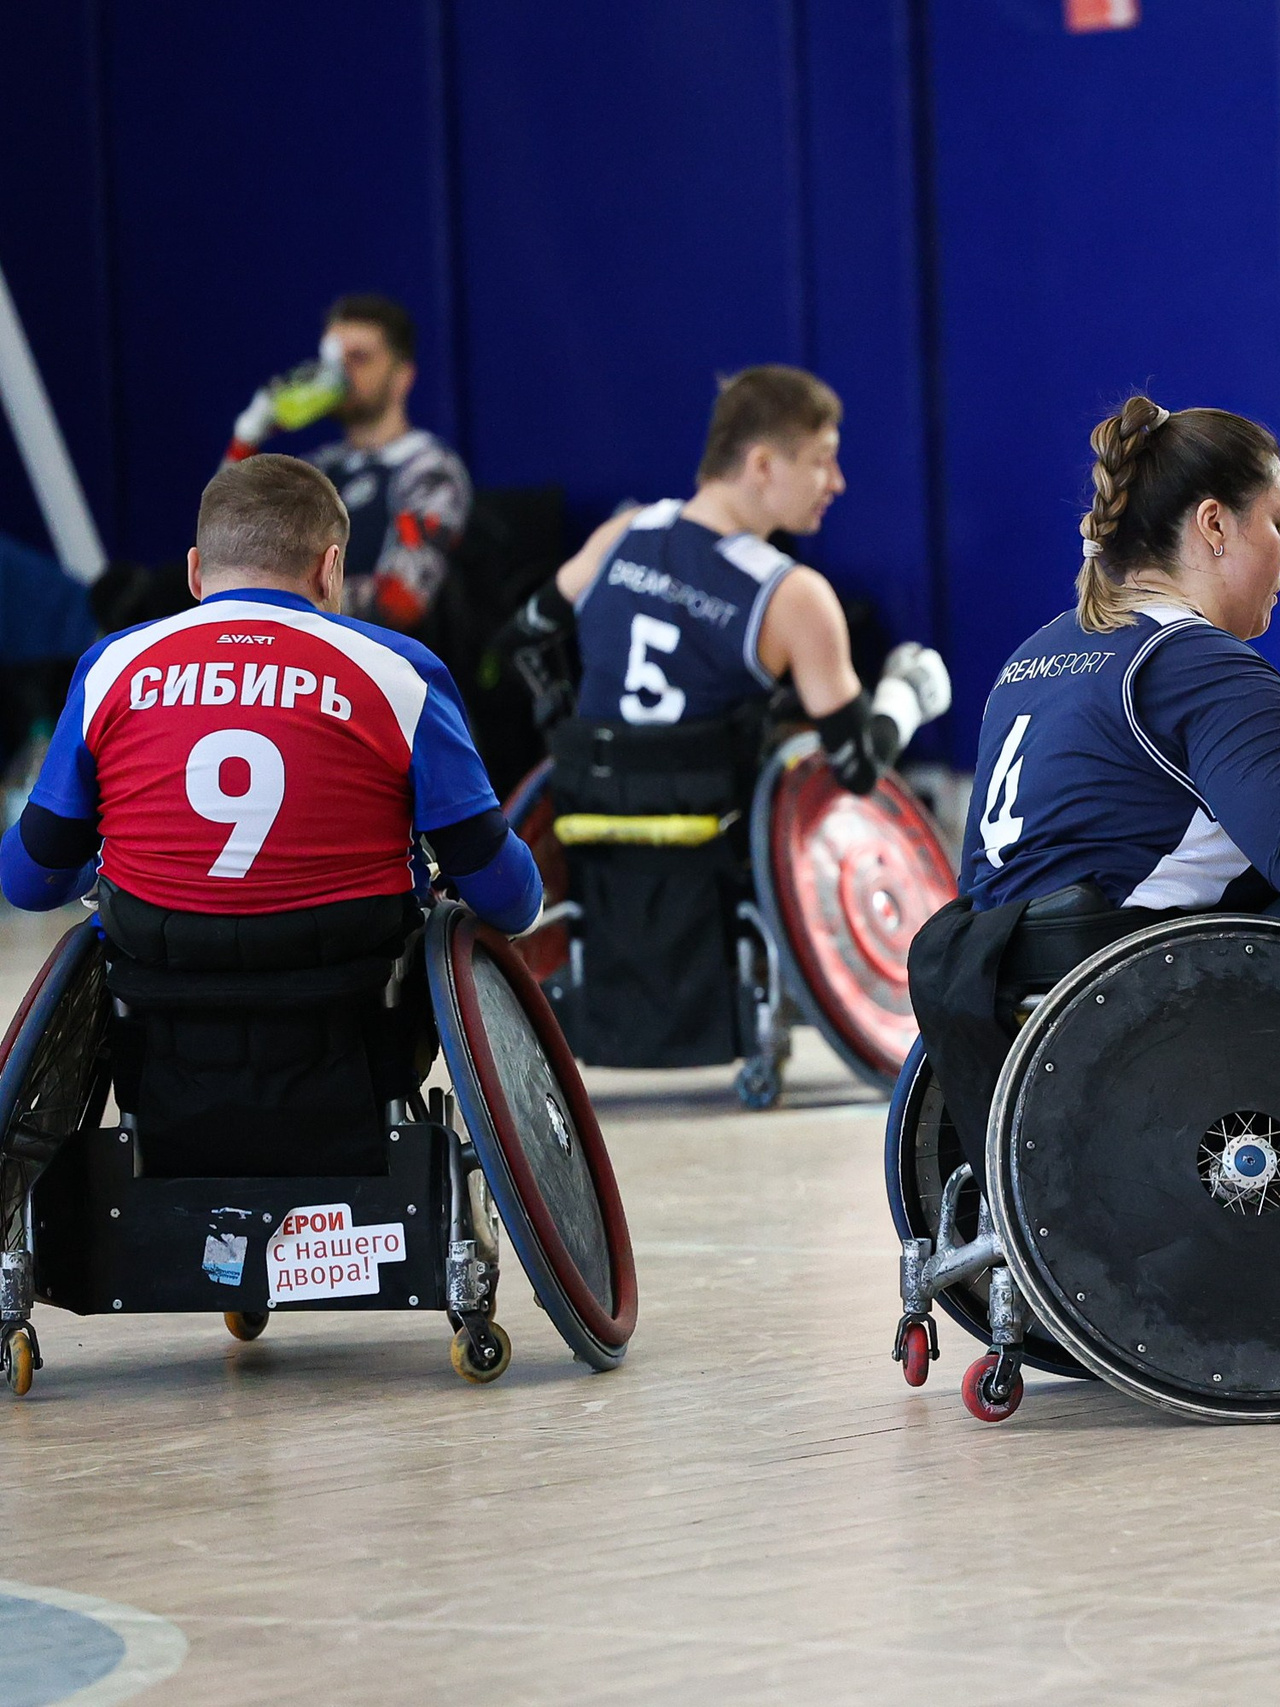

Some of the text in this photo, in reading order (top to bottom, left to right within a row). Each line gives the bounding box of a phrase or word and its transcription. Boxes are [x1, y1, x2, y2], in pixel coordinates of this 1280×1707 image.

[608, 558, 739, 629] DREAMSPORT
[216, 634, 276, 646] SVART
[619, 612, 686, 726] 5
[129, 662, 353, 721] СИБИРЬ
[185, 728, 285, 879] 9
[979, 714, 1032, 869] 4
[273, 1211, 345, 1238] ЕРОИ
[273, 1233, 400, 1262] с нашего
[275, 1256, 371, 1292] двора!
